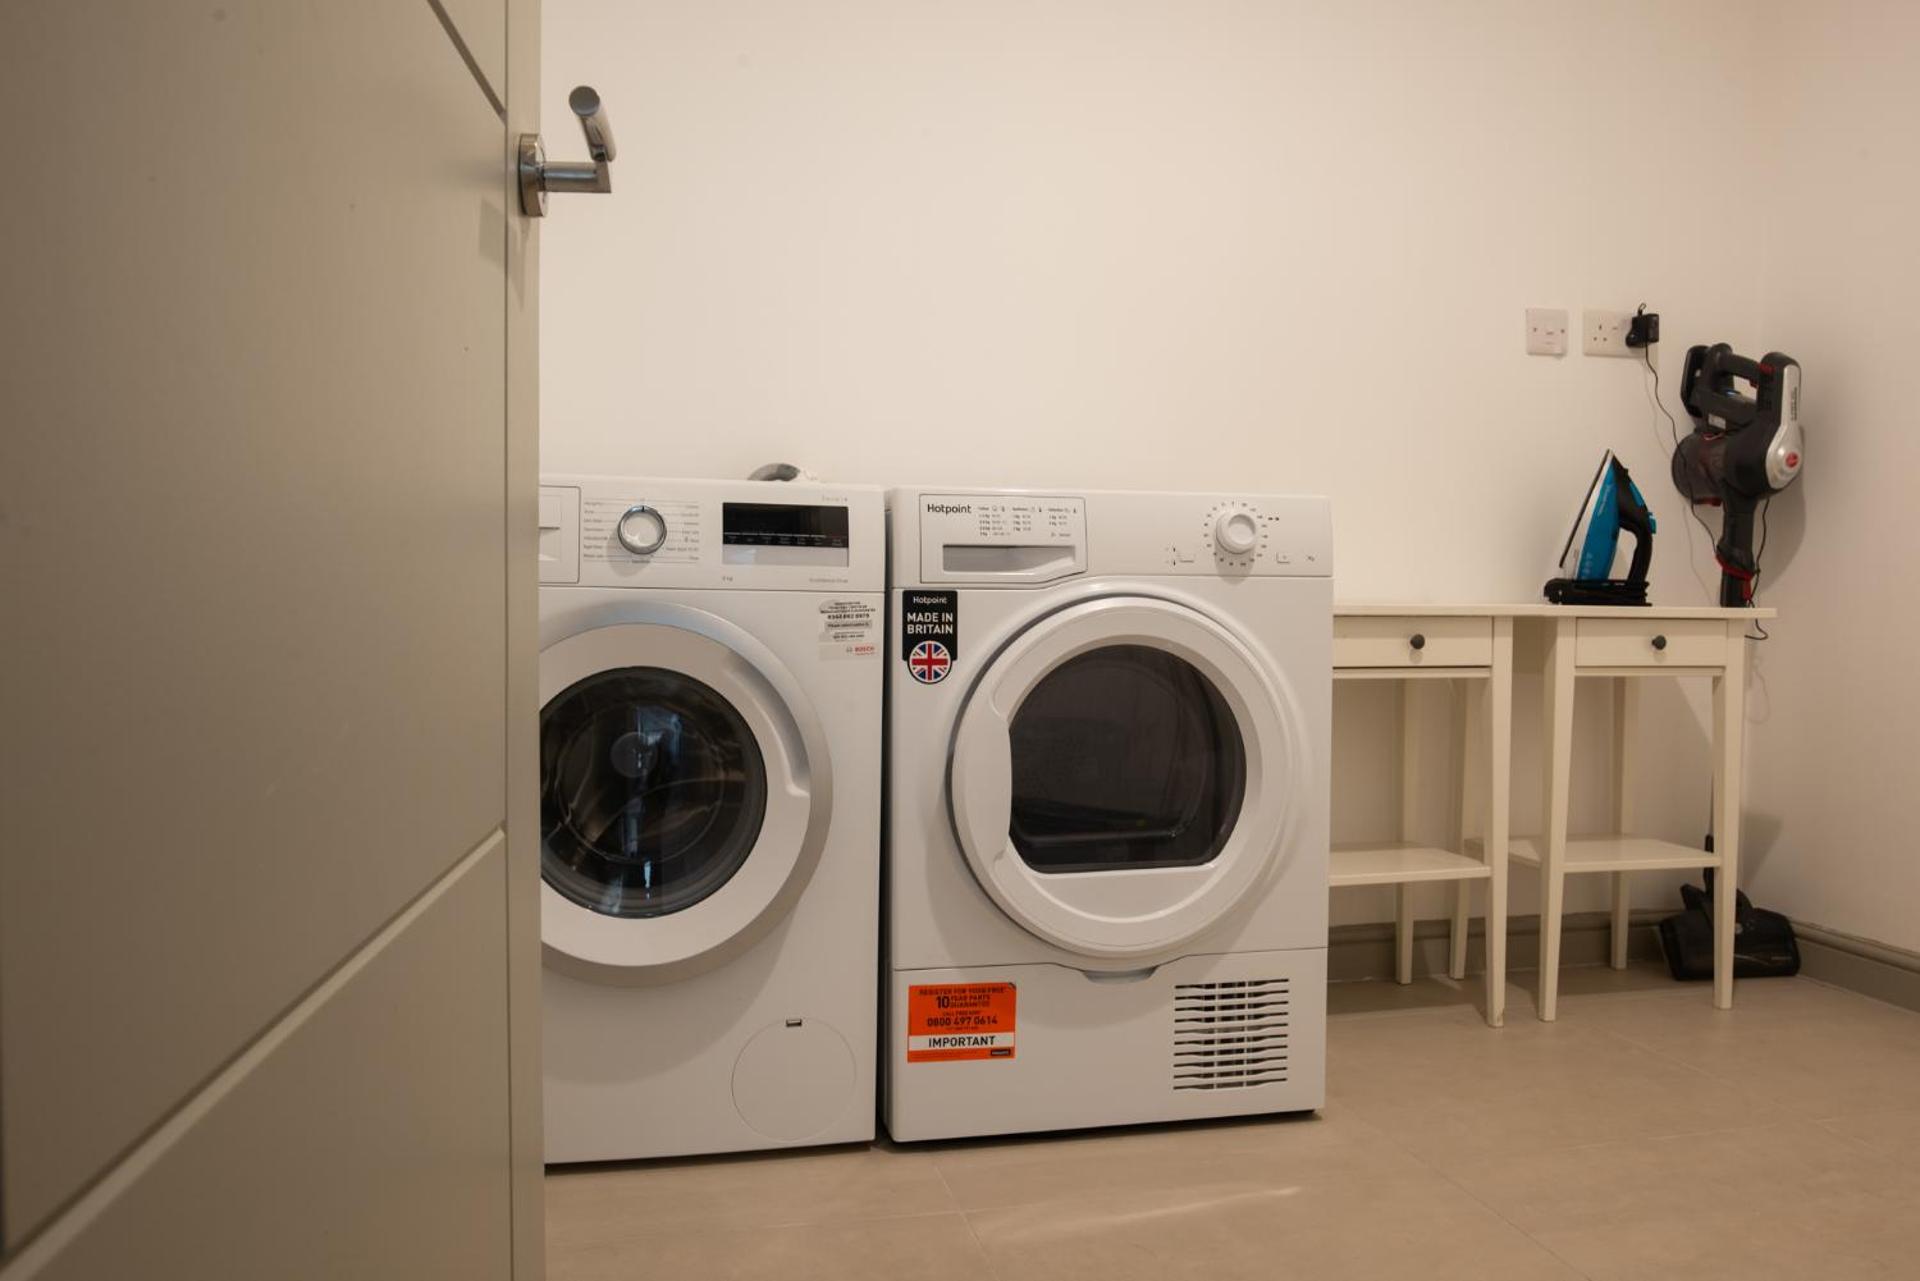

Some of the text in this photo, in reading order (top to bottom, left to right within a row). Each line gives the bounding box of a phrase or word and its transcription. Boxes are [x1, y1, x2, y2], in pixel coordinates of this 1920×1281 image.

[927, 504, 972, 516] Hotpoint
[913, 596, 948, 606] Hotpoint
[907, 612, 953, 622] MADE IN
[907, 624, 953, 634] BRITAIN
[936, 995, 950, 1009] 10
[927, 1015, 998, 1027] 0800 497 0614
[928, 1035, 996, 1048] IMPORTANT
